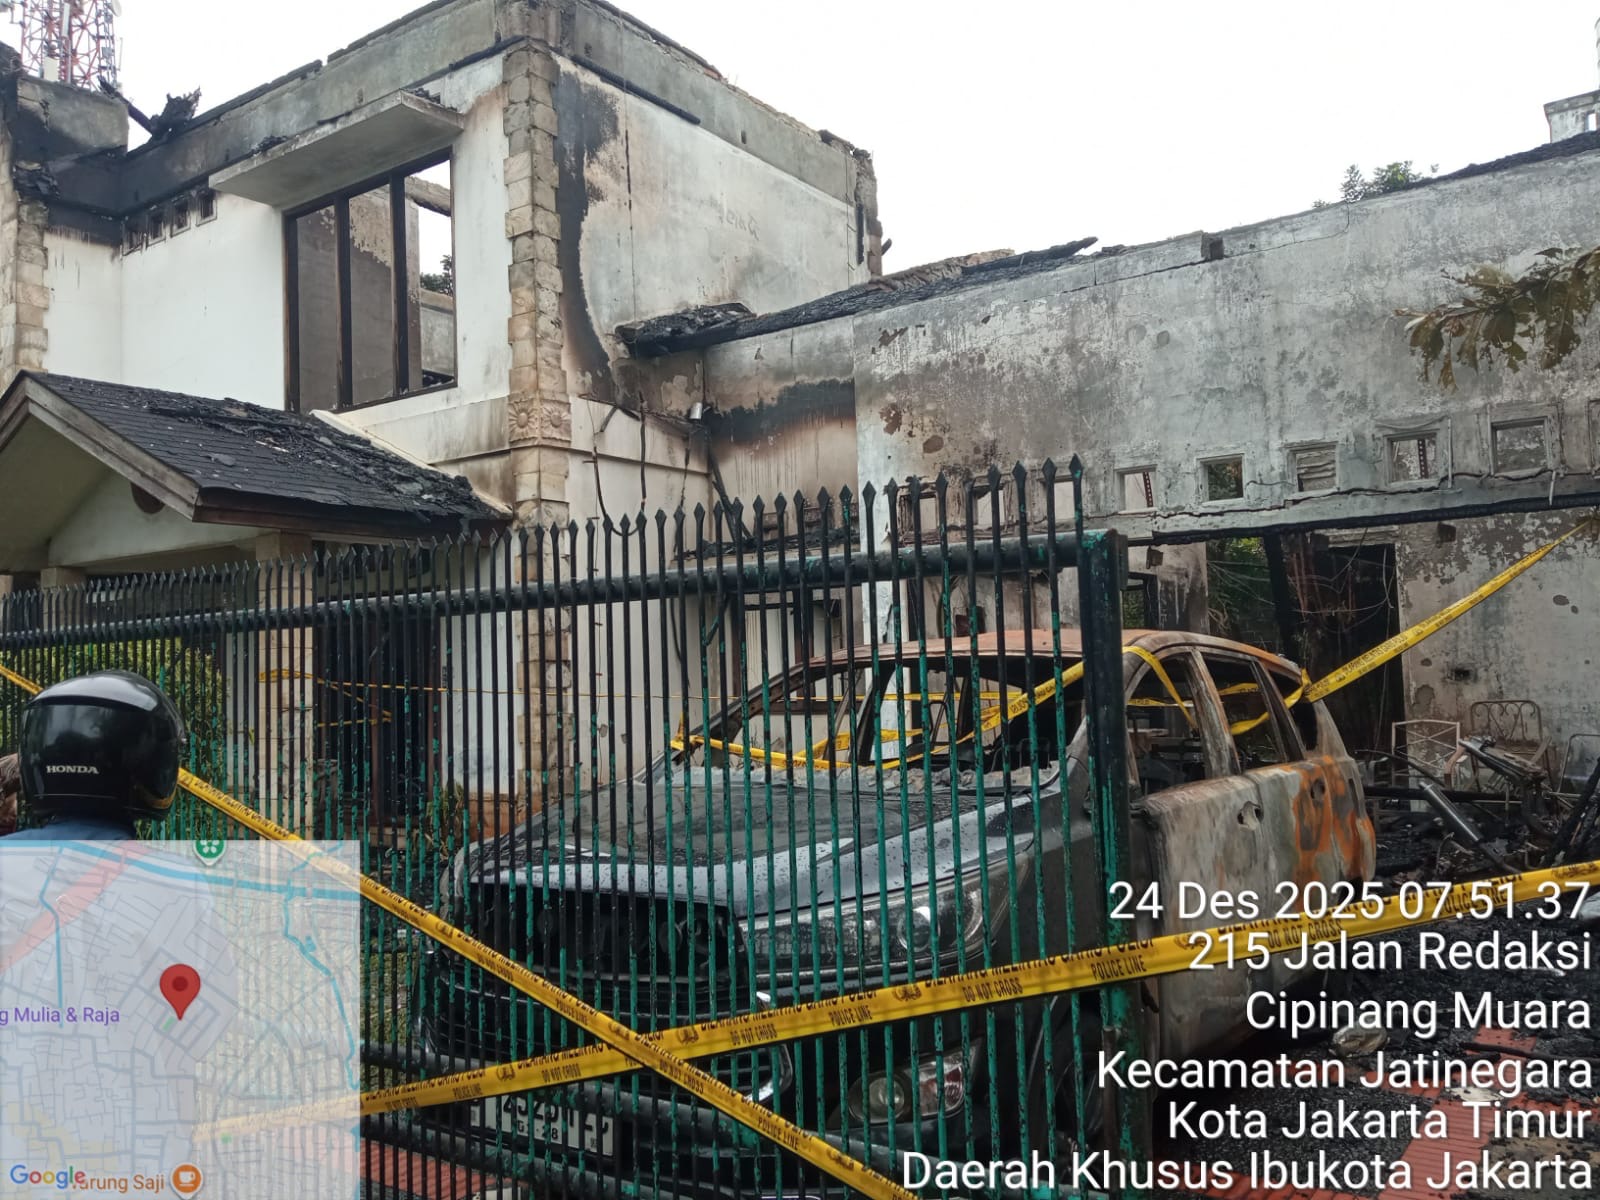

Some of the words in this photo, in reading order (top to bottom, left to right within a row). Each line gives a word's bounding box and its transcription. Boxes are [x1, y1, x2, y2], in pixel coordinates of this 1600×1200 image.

[46, 764, 99, 775] HONDA
[1307, 919, 1343, 940] CROSS
[1091, 959, 1125, 981] POLICE
[1126, 955, 1148, 975] LINE
[962, 985, 973, 1003] DO
[974, 982, 994, 1001] NOT
[994, 977, 1024, 998] CROSS
[828, 1008, 855, 1027] POLICE
[854, 1004, 873, 1022] LINE
[758, 1116, 782, 1140] POLICE
[783, 1129, 799, 1151] LINE
